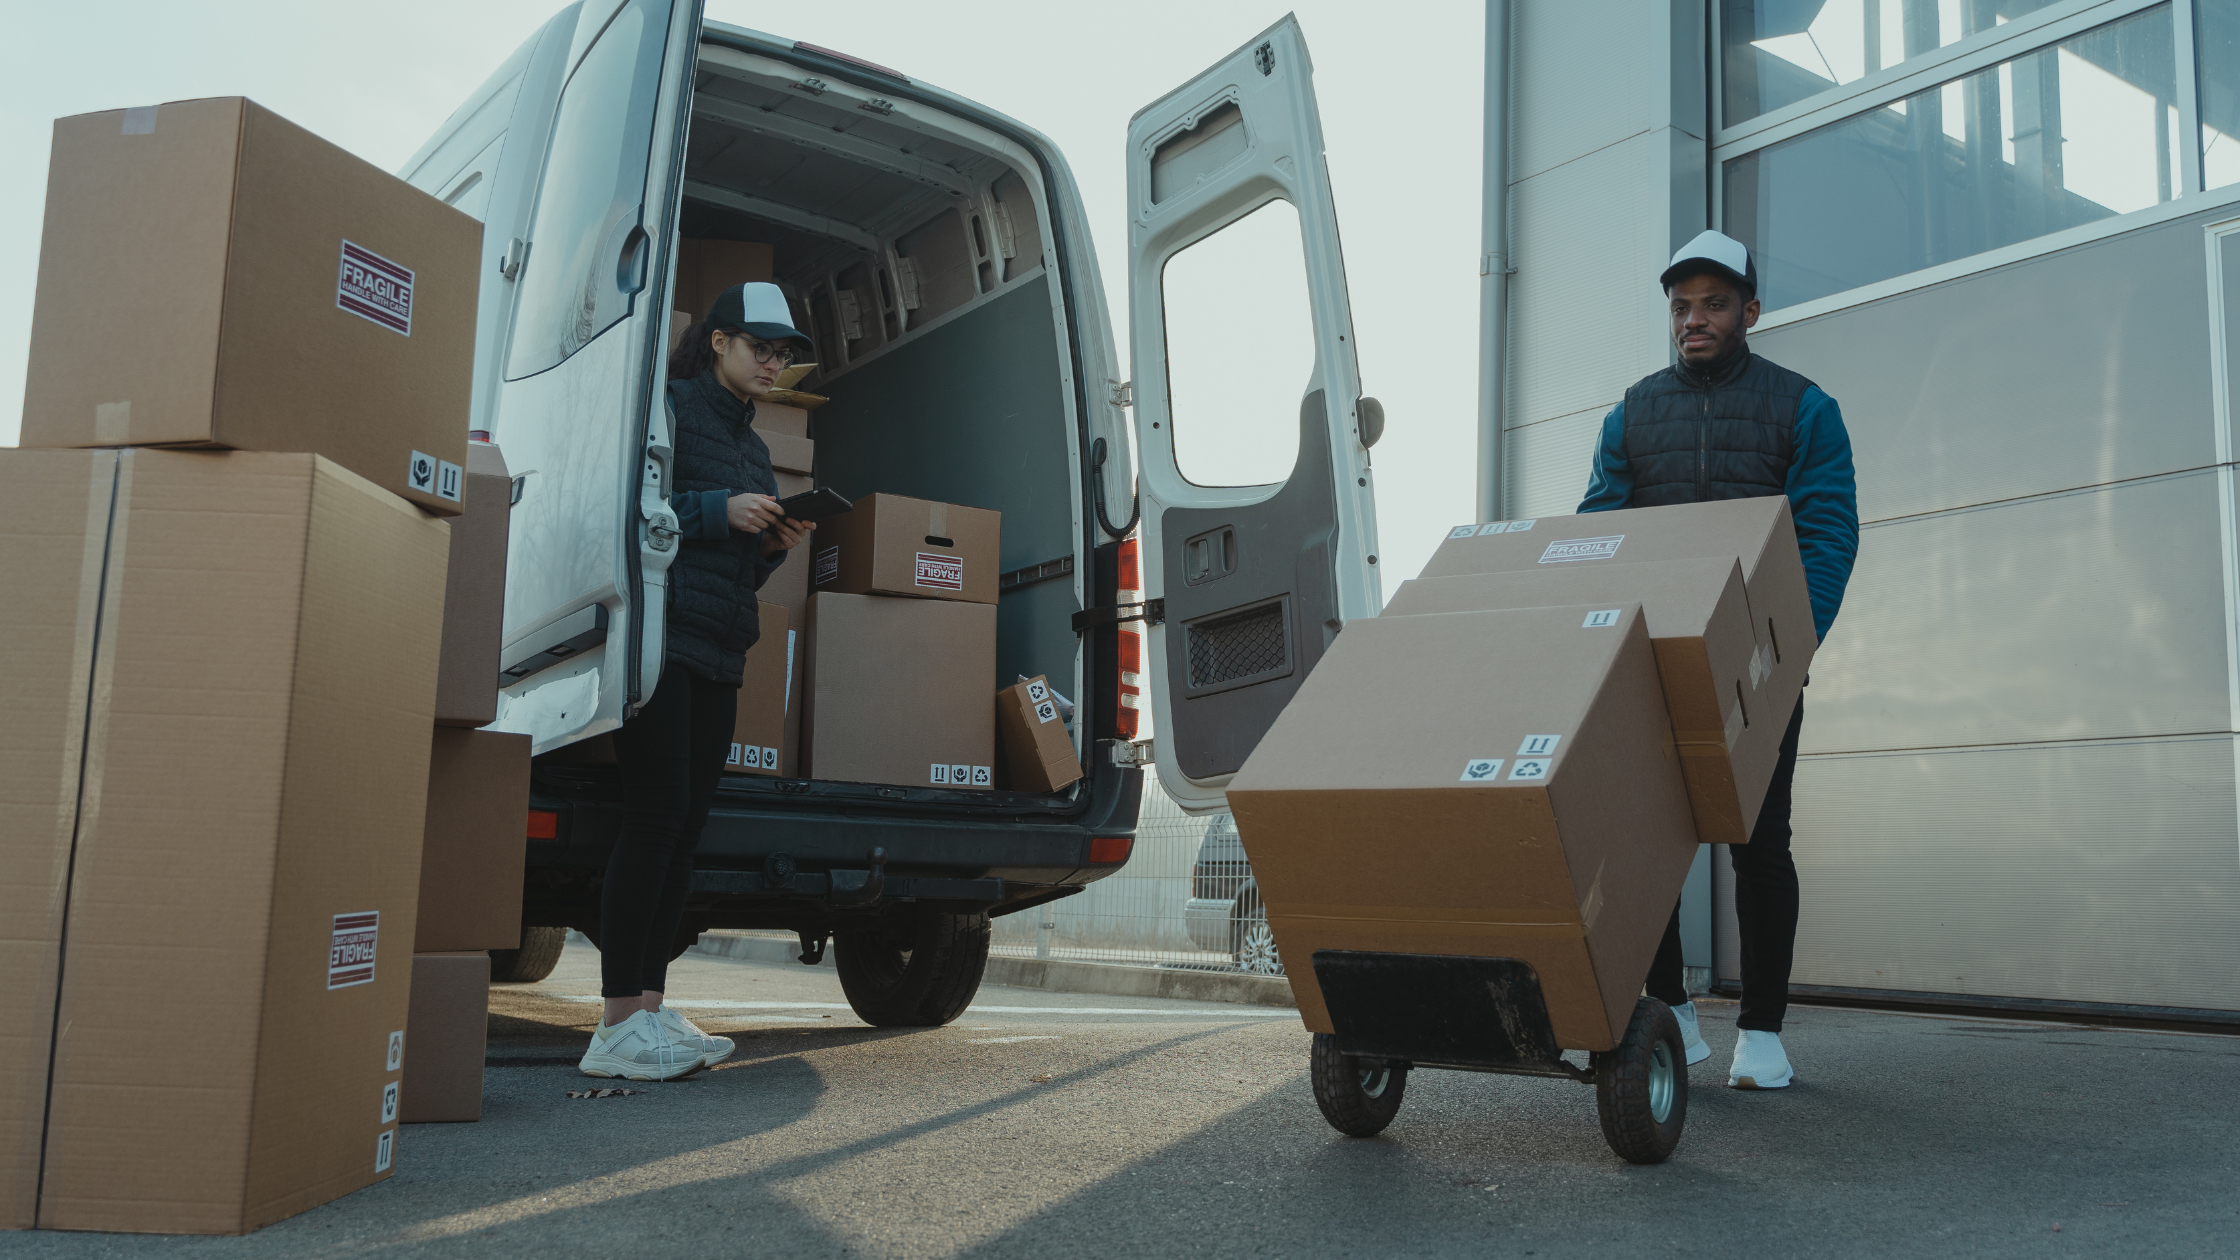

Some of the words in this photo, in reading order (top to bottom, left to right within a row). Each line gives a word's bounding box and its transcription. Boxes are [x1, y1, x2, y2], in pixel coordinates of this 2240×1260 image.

[343, 262, 409, 308] FRAGILE
[342, 281, 371, 299] HANDLE
[372, 294, 389, 307] WITH
[389, 302, 408, 316] CARE
[1548, 542, 1617, 554] FRAGILE
[918, 567, 960, 580] FRAGILE
[332, 941, 375, 965] FRAGILE
